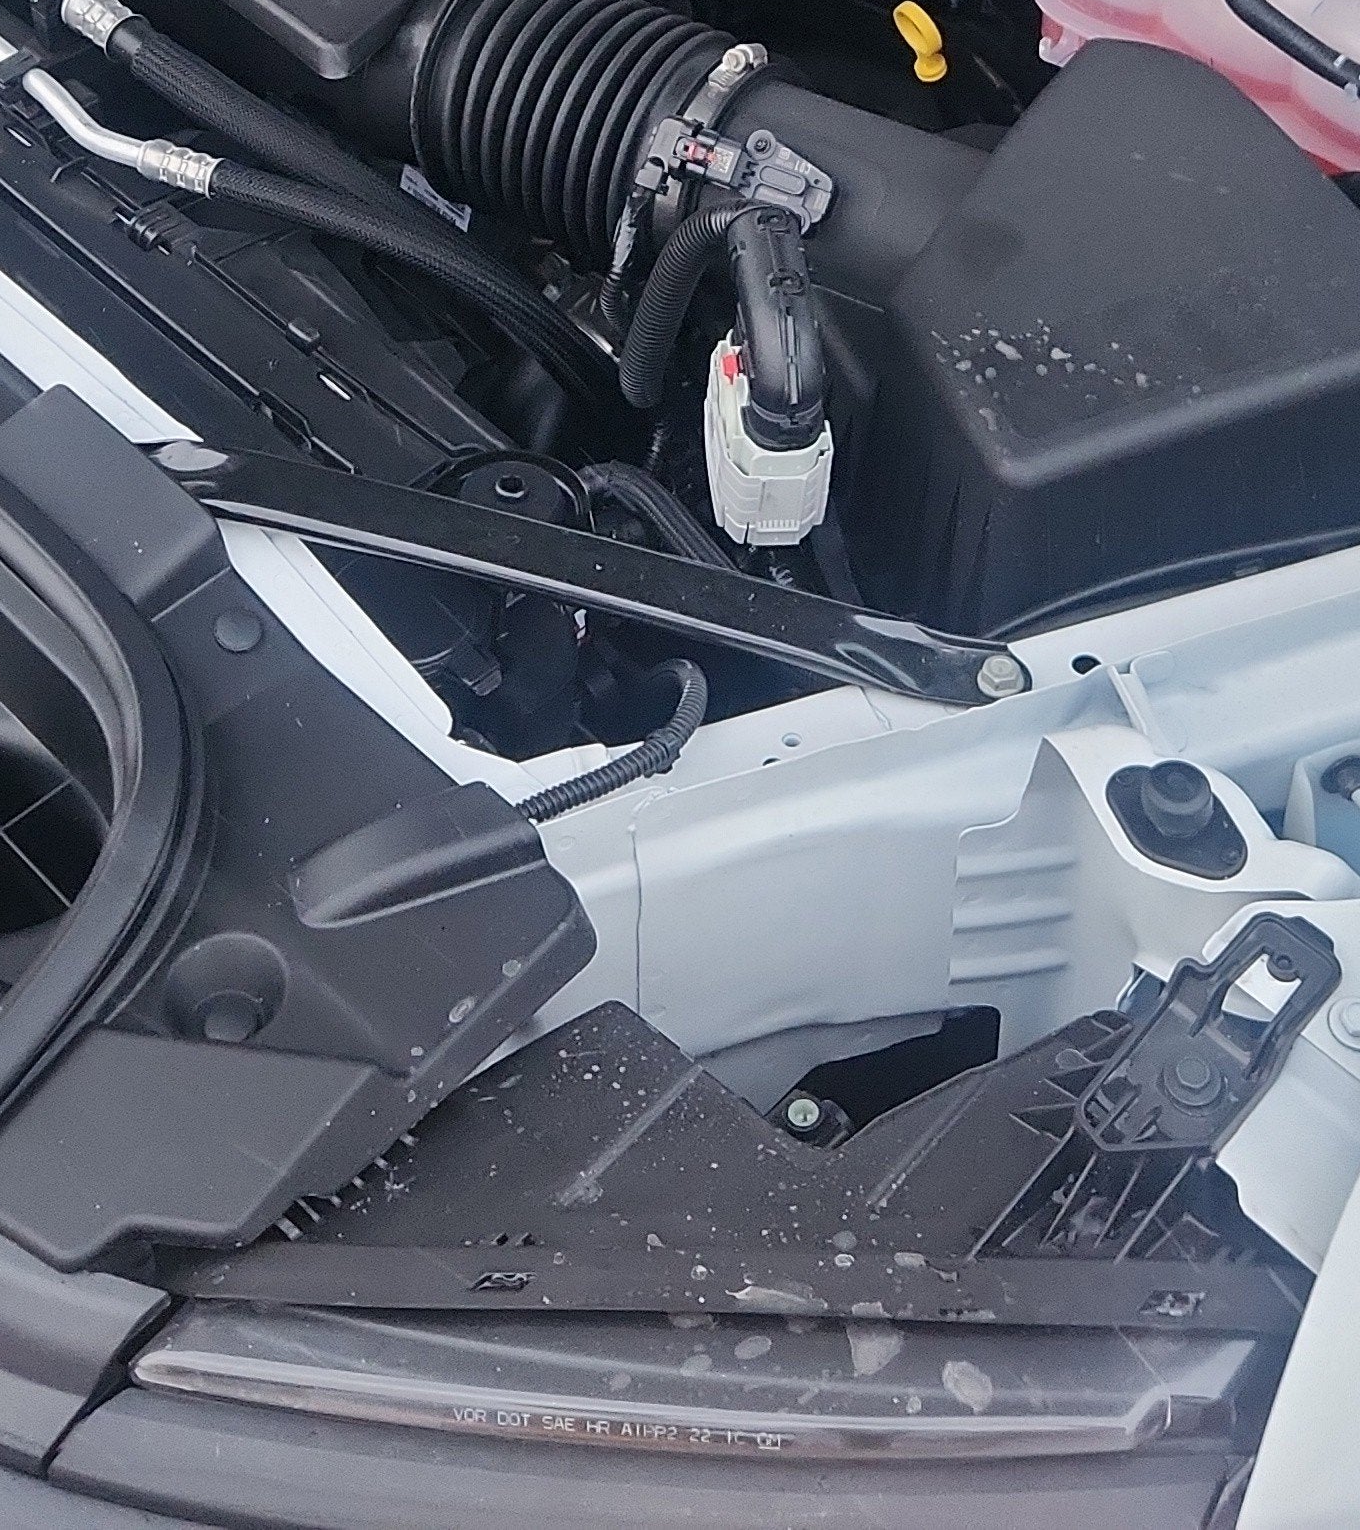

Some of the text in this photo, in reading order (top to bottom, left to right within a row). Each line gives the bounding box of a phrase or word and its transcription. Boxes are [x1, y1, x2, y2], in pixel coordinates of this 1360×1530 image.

[453, 1407, 487, 1423] VOR
[497, 1410, 531, 1427] DOT
[541, 1415, 575, 1432] SAE
[586, 1420, 610, 1435] HR
[689, 1427, 711, 1443] 22
